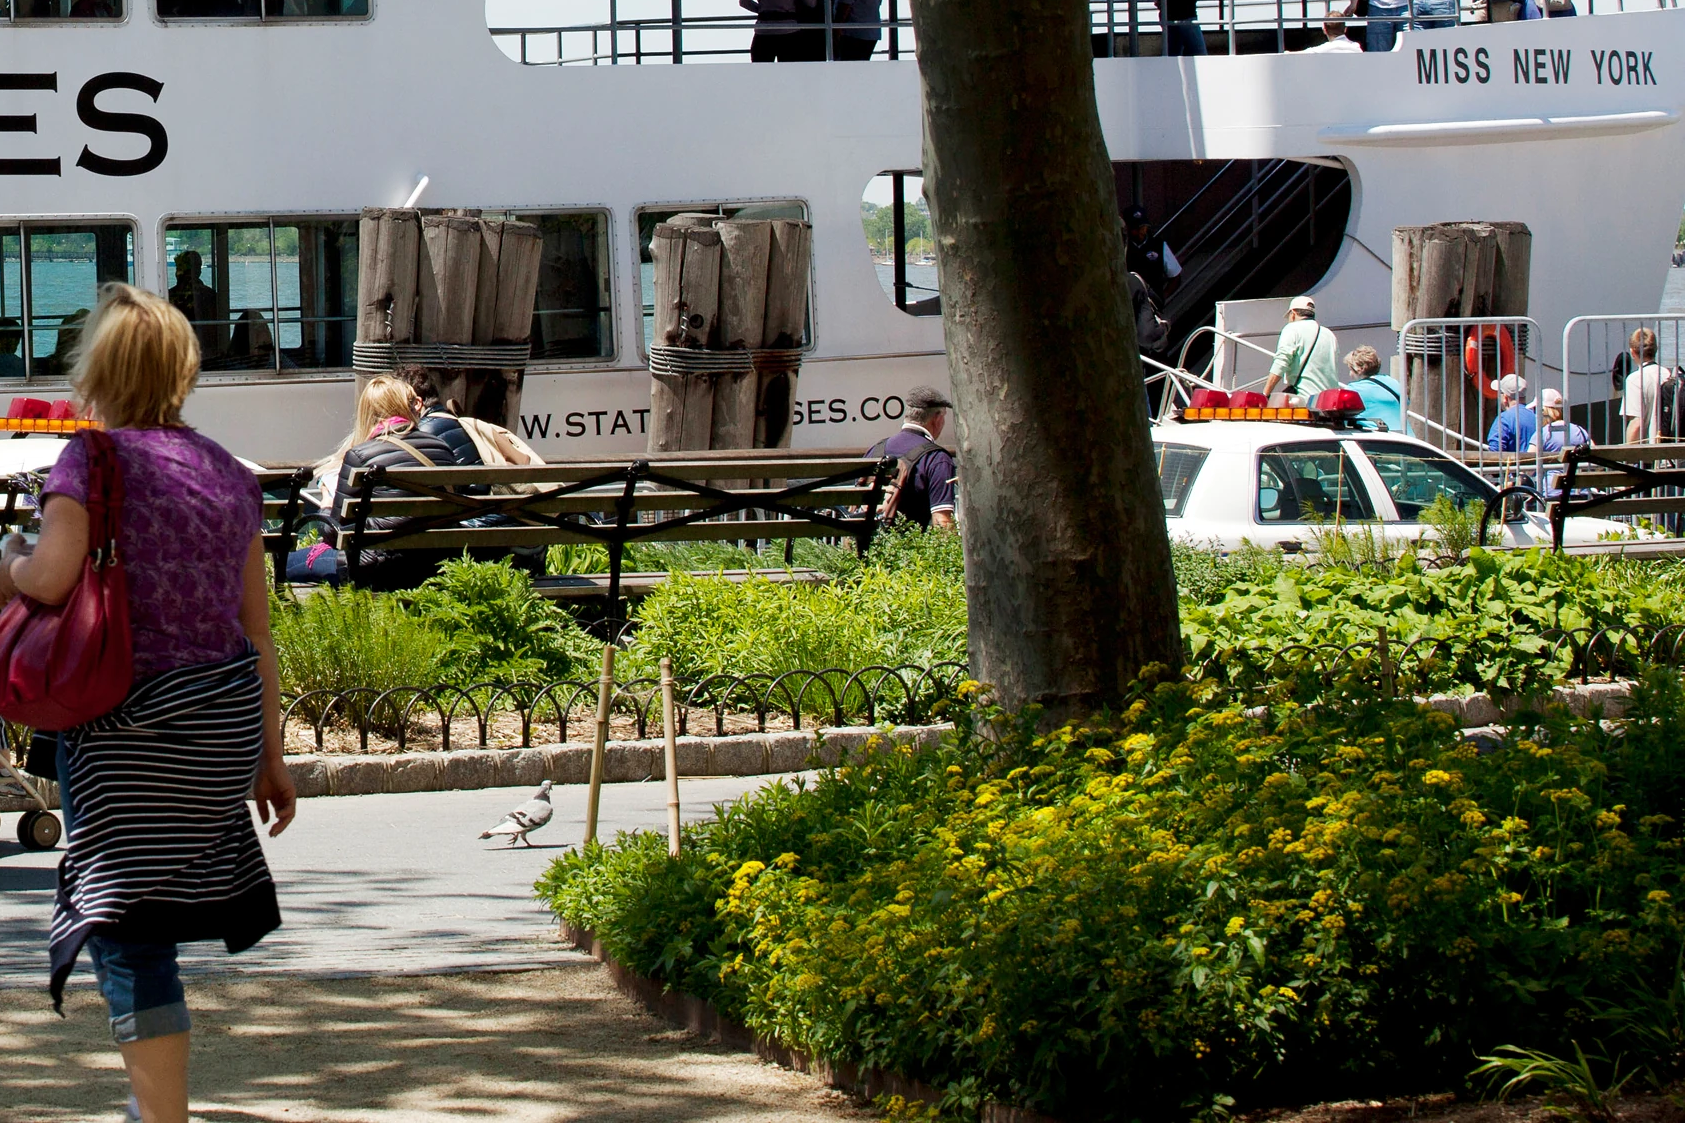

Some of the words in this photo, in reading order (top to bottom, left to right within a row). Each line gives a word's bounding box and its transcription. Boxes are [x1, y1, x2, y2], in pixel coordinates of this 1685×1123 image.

[1416, 47, 1491, 84] MISS
[1513, 48, 1571, 85] NEW
[1590, 50, 1657, 86] YORK
